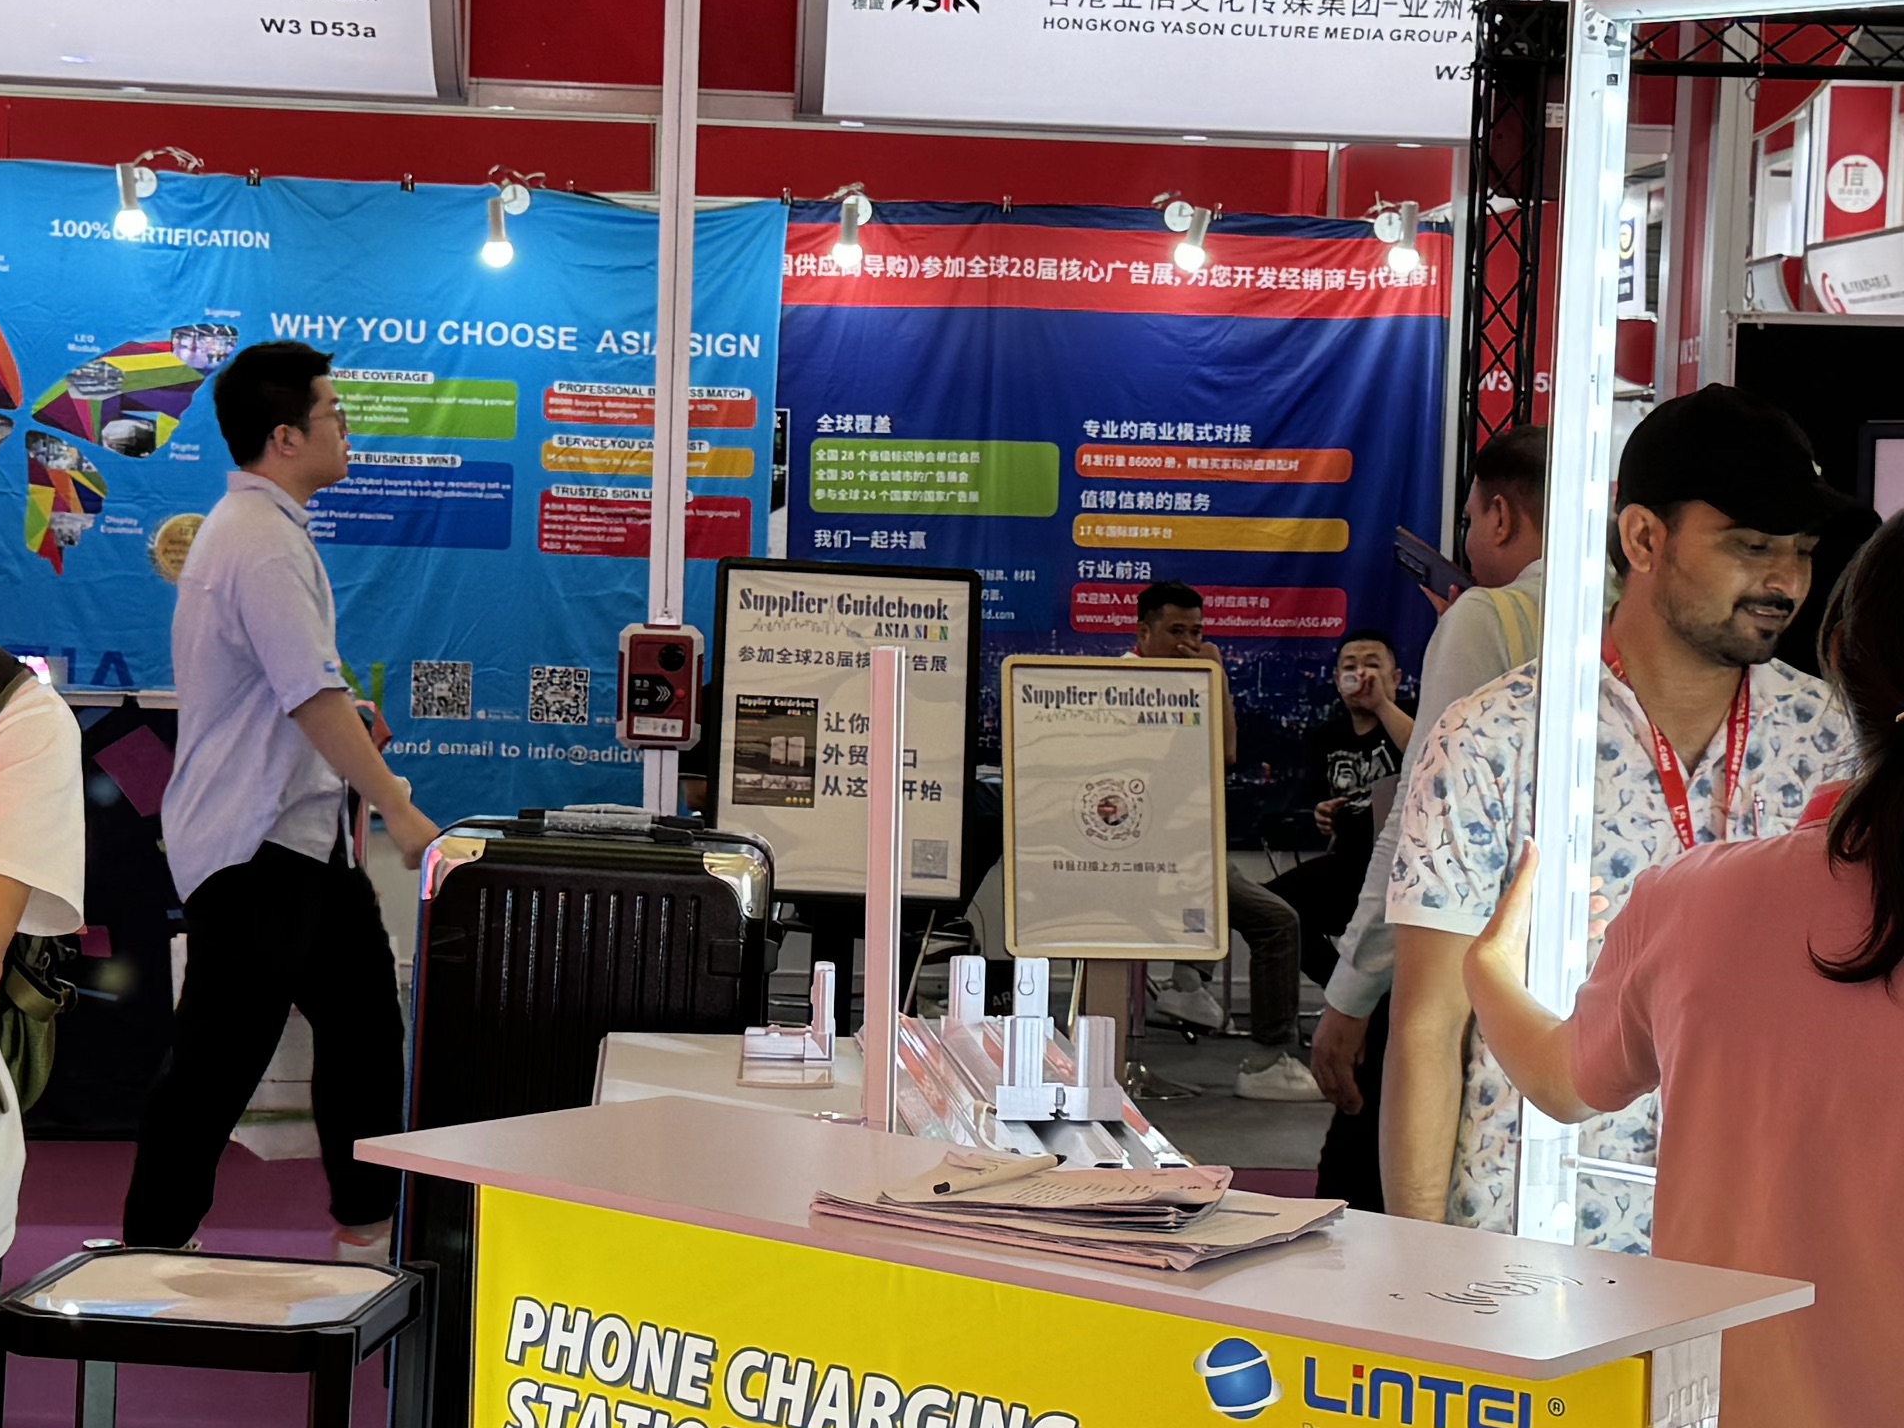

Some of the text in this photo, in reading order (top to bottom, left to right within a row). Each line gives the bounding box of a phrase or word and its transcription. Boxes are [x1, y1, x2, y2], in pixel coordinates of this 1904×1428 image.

[259, 17, 377, 39] W3 D53a
[1042, 16, 1156, 35] HONGKONG
[1161, 20, 1226, 37] YASON
[1230, 23, 1320, 40] CULTURE
[1323, 26, 1385, 42] MEDIA
[1389, 28, 1458, 44] GROUP
[270, 313, 347, 341] WHY
[357, 317, 427, 344] YOU
[437, 320, 578, 352] CHOOSE
[595, 329, 658, 356] ASI
[362, 371, 429, 383] COVERAGE
[558, 382, 746, 399] PROFESSIONAL MATCH
[816, 414, 892, 434] 全球覆盖
[1082, 419, 1252, 443] 专业的商业模式对接
[557, 436, 636, 451] SERVICE YOU
[364, 454, 457, 467] BUSINESS WINS
[554, 486, 640, 501] TRUSTED SIGN
[1080, 489, 1211, 511] 值得信赖的服务
[814, 529, 927, 550] 我们一起共赢
[1078, 559, 1152, 580] 行业前沿
[739, 587, 949, 621] Supplier Guidebook
[874, 622, 949, 641] ASIA SIGN
[1022, 684, 1200, 709] Supplier Guidebook
[1137, 711, 1167, 725] ASIA
[438, 741, 494, 758] email
[501, 742, 521, 758] to
[505, 1296, 717, 1408] PHONE
